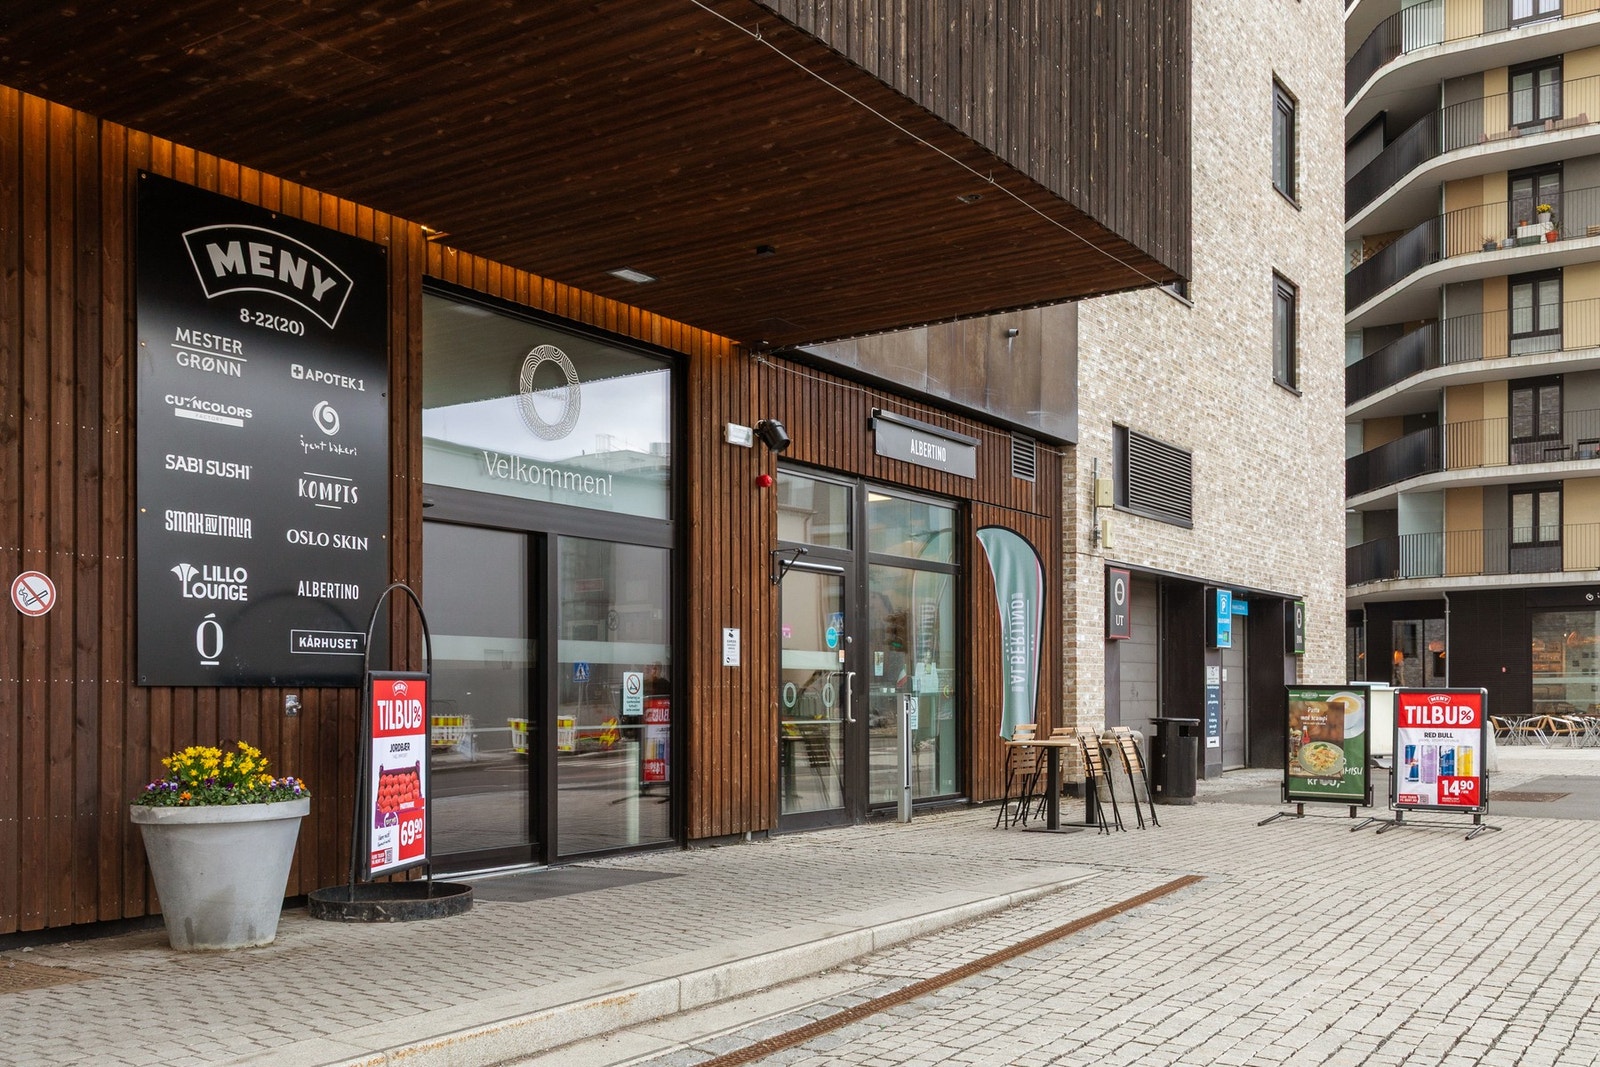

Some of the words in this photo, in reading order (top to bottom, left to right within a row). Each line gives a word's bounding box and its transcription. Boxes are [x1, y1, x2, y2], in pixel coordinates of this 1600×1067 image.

[206, 241, 337, 302] MENY
[239, 308, 305, 336] 8-22(20)
[175, 327, 243, 355] MESTER
[175, 351, 242, 378] GRØNN
[305, 367, 357, 390] APOTEK
[358, 379, 365, 391] 1
[329, 441, 358, 456] bakeri
[910, 438, 947, 462] ALBERTINO
[165, 454, 203, 474] SABI
[206, 460, 250, 480] SUSHI
[483, 450, 613, 496] Velkommen!
[298, 478, 359, 505] KOMPIS
[165, 509, 204, 533] SMAK
[205, 516, 218, 534] AV
[218, 516, 252, 539] ITALIA
[286, 529, 330, 547] OSLO
[332, 534, 369, 551] SKIN
[203, 564, 248, 582] LILLO
[182, 581, 248, 601] LOUNGE
[297, 580, 360, 600] ALBERTINO
[1115, 614, 1124, 626] UT
[299, 633, 358, 650] KÅRHUSET
[377, 699, 423, 731] TILBUD
[1404, 705, 1475, 725] TILBUD
